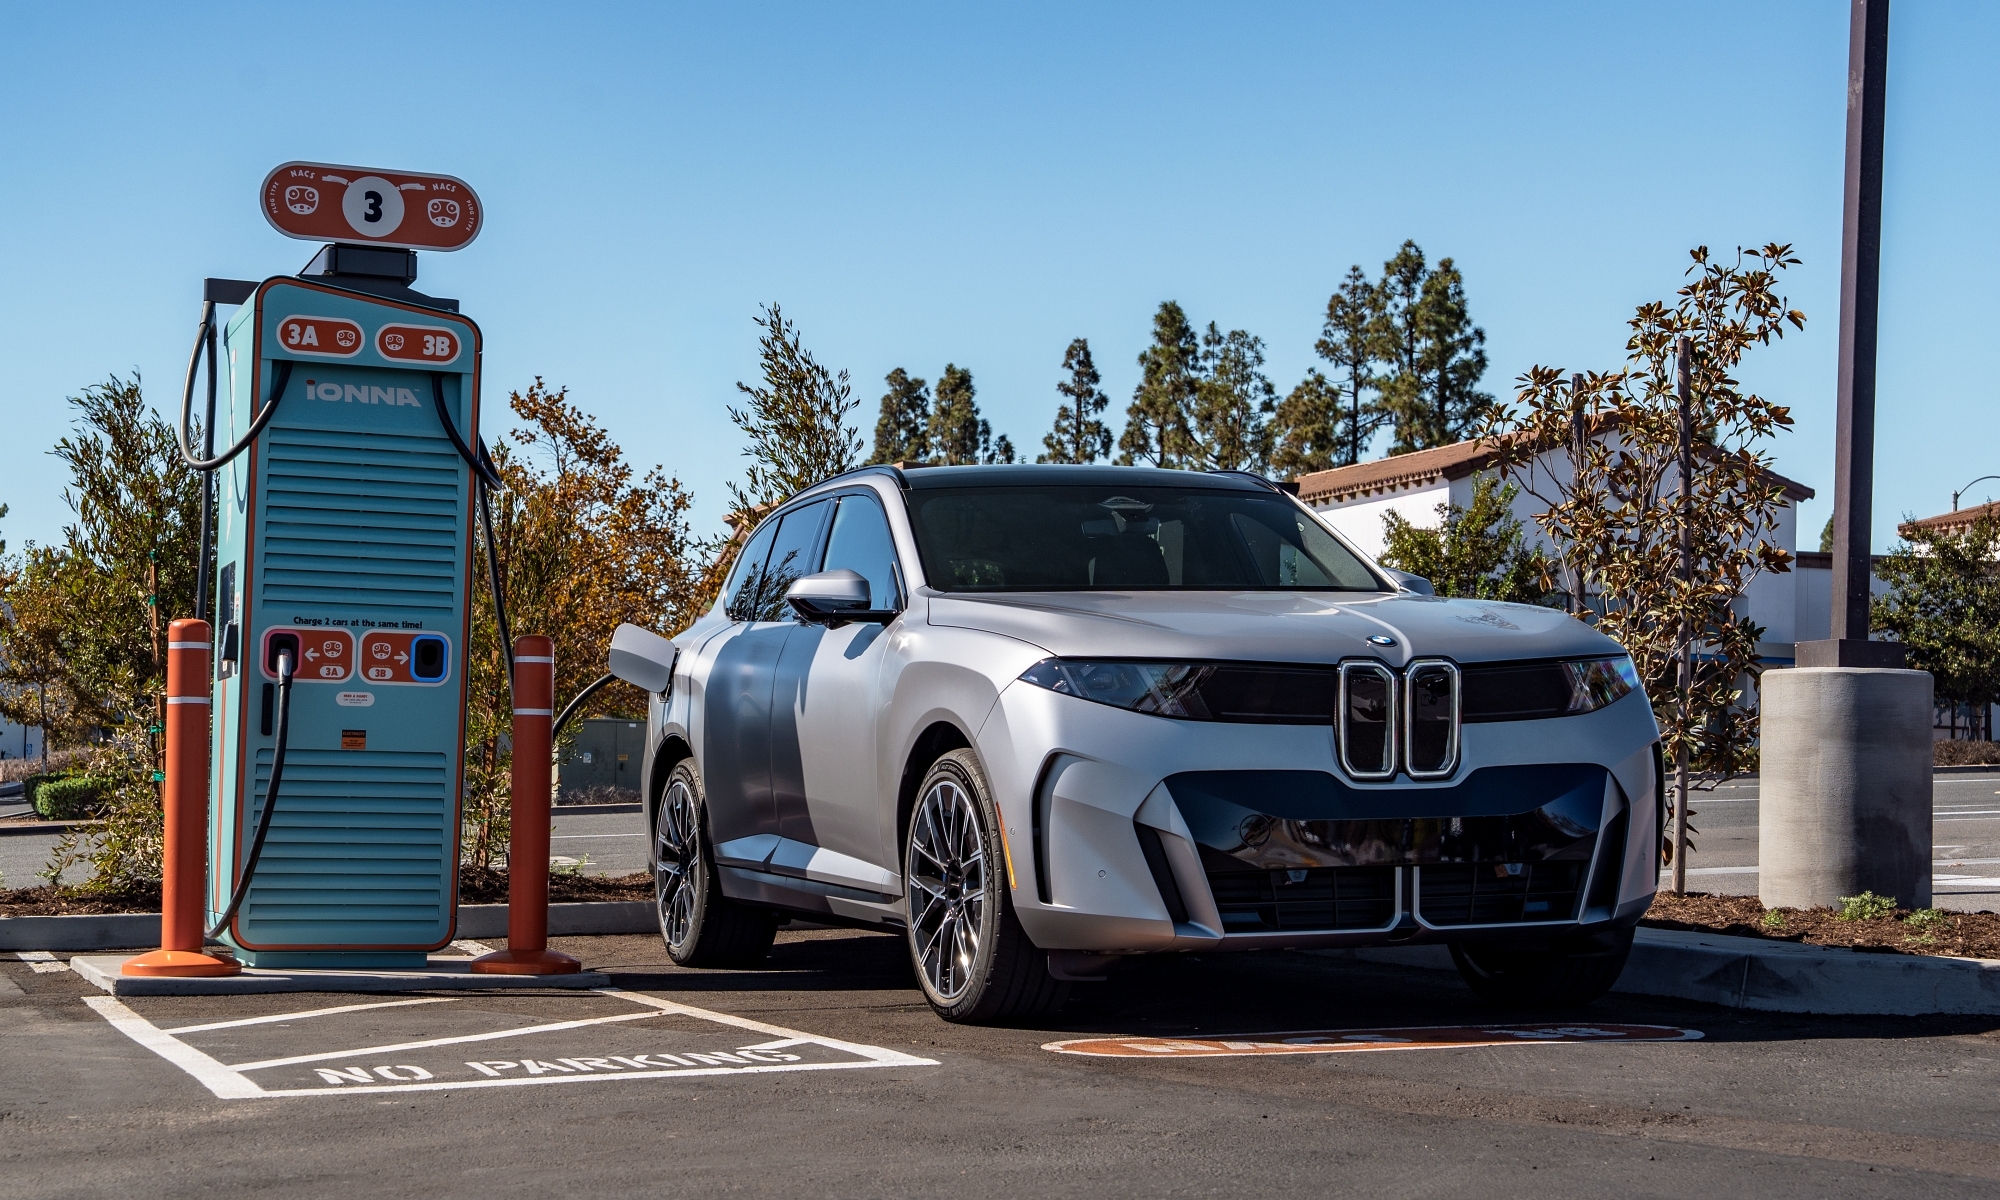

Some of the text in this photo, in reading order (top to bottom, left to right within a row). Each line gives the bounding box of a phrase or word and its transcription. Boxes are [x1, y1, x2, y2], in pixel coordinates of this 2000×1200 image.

[290, 169, 316, 180] NACS
[269, 181, 280, 214] PLUG TYPE
[432, 183, 457, 193] NACS
[364, 190, 383, 223] 3
[465, 199, 475, 232] PLUG TYPE
[287, 323, 319, 347] 3A
[422, 334, 450, 357] 3B
[293, 616, 423, 629] Charge 2 cars at the same time!
[325, 667, 338, 677] 3A
[374, 669, 387, 678] 3B
[314, 1048, 802, 1085] NO PARKING
